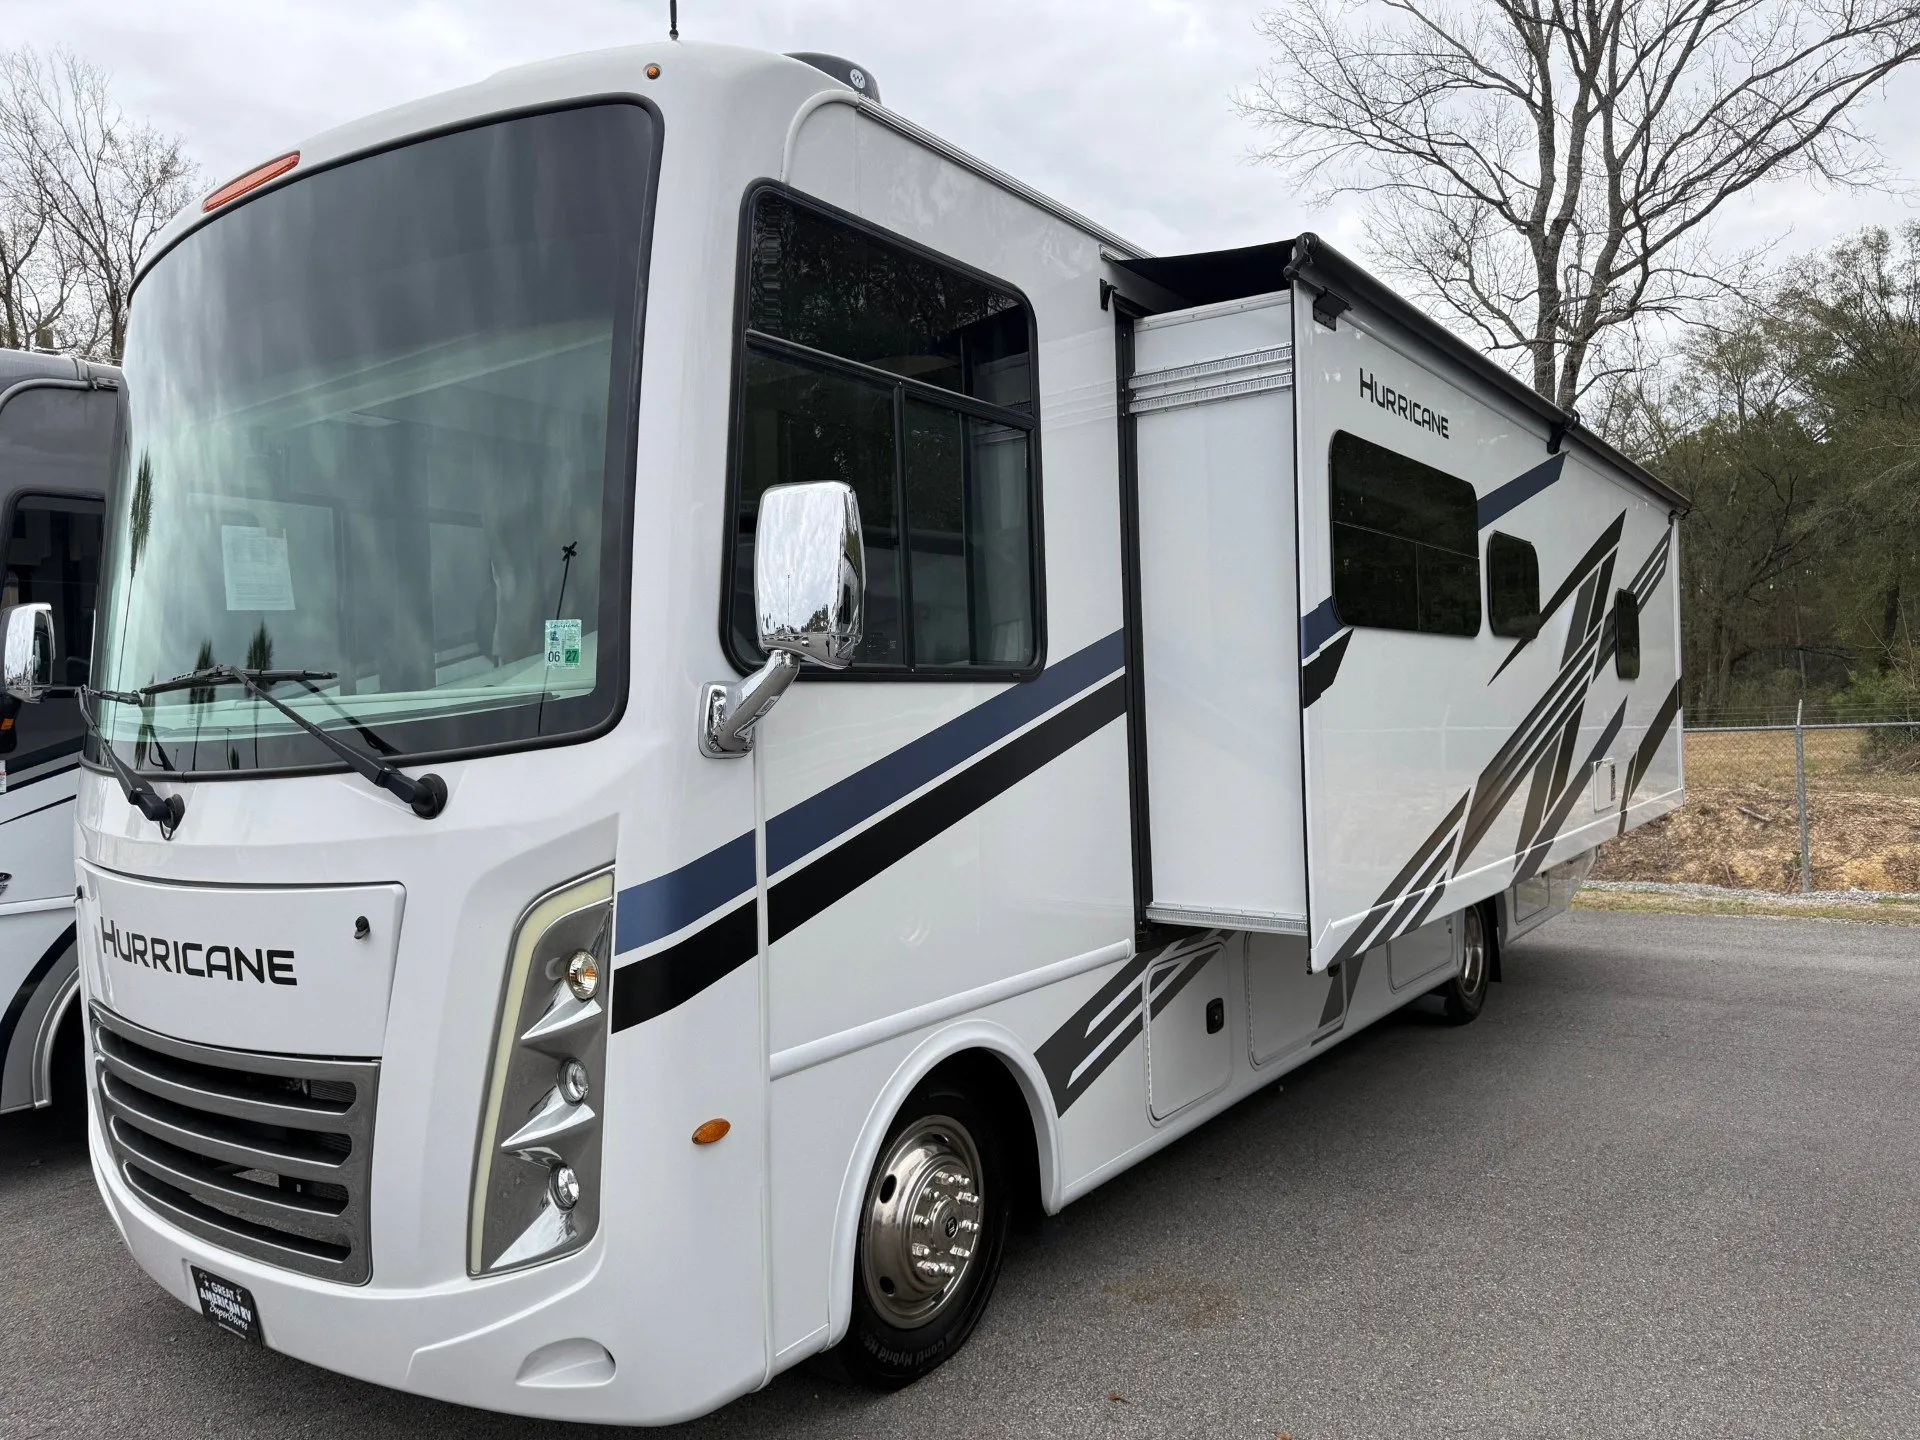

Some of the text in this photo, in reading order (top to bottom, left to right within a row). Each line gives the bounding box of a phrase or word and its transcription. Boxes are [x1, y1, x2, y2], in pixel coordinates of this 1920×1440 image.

[1360, 367, 1449, 440] HURRICANE
[548, 650, 578, 662] 06 27
[100, 916, 298, 986] HURRICANE
[200, 1288, 251, 1322] AMERICAN RV
[211, 1282, 234, 1301] GREAT
[877, 1347, 913, 1367] Hybrid
